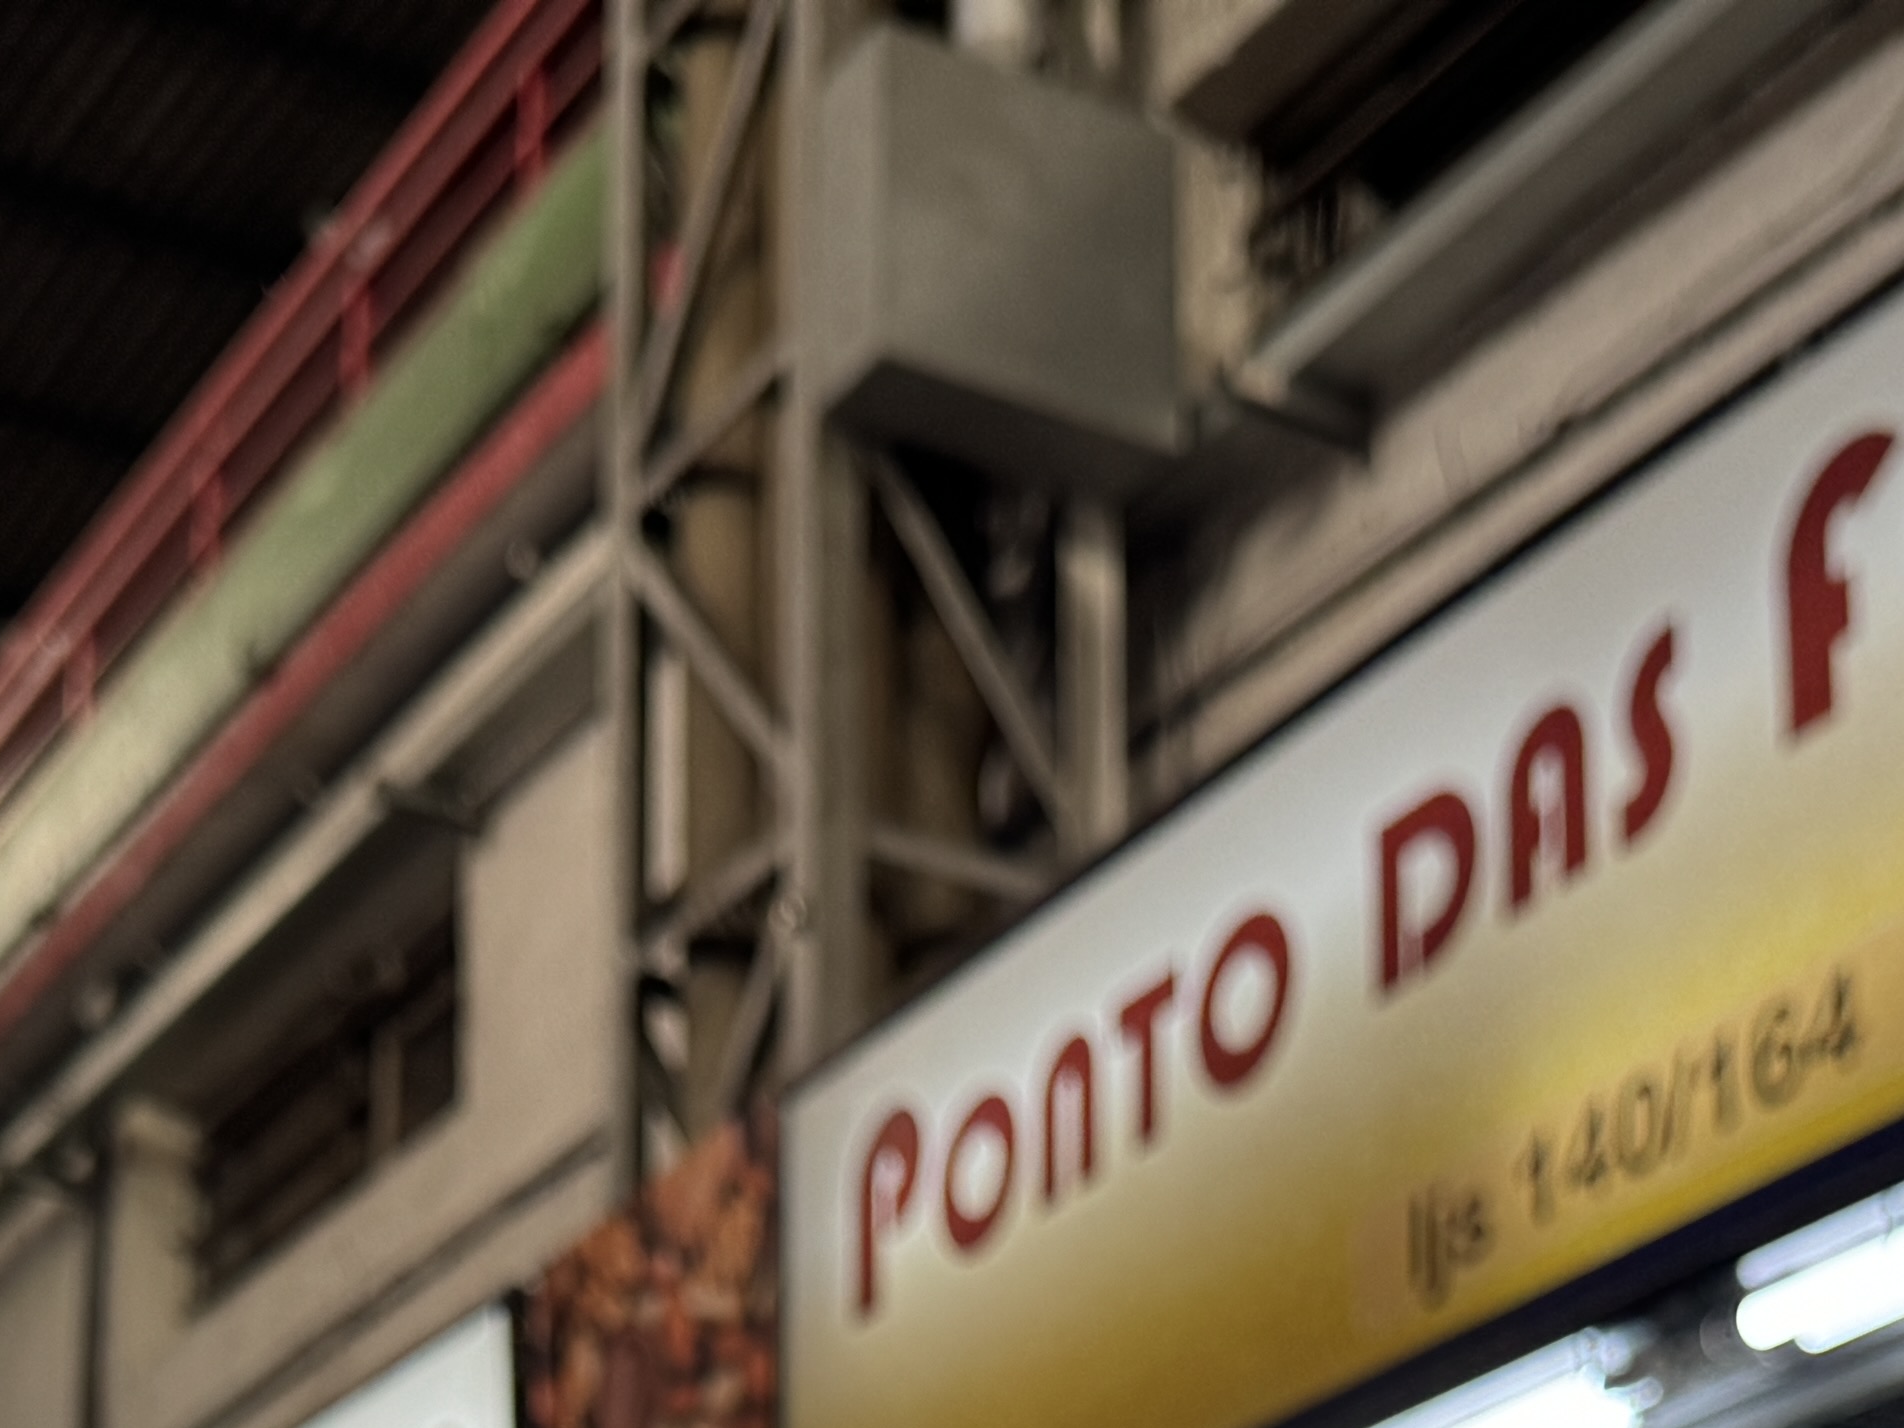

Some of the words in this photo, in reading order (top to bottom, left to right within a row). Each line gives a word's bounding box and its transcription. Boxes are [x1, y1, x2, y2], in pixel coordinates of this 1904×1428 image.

[858, 912, 1290, 1314] PONTO
[1379, 620, 1675, 994] DAS
[1514, 965, 1860, 1218] 140/164
